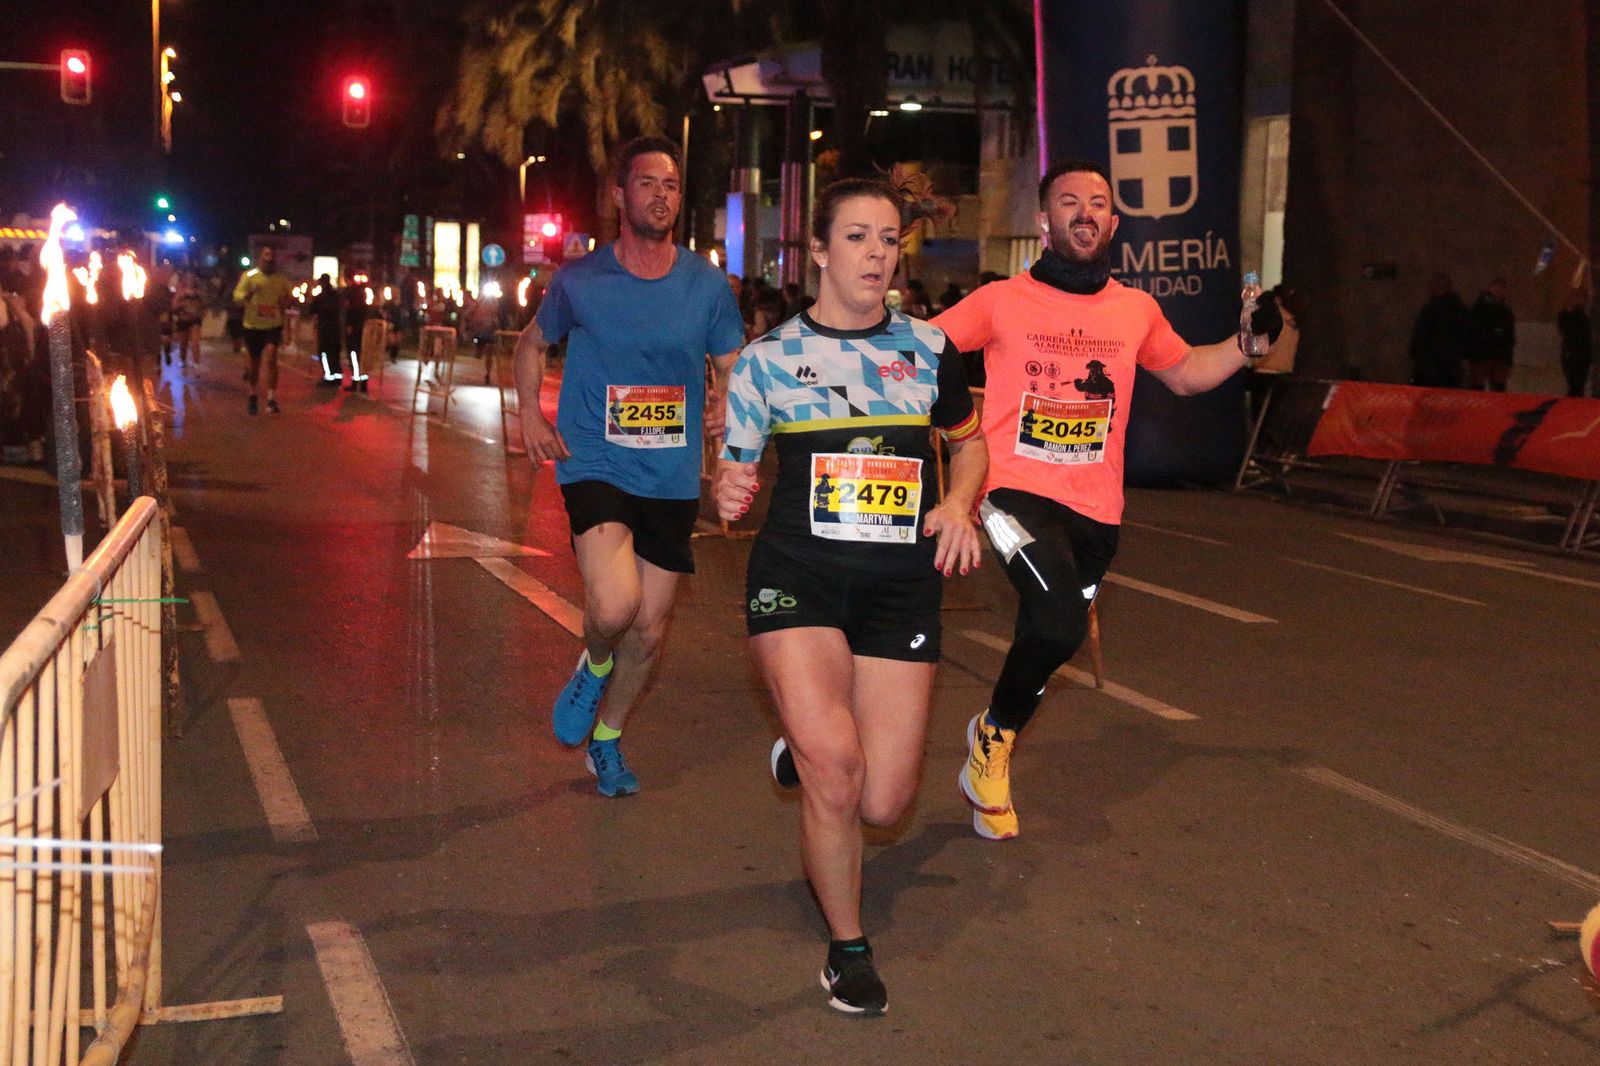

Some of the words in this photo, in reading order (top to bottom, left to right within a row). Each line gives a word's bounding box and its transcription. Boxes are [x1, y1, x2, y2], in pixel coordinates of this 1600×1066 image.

[883, 52, 933, 80] RAN
[1111, 230, 1232, 273] MERÍA
[1026, 333, 1072, 345] CARRERA
[1074, 339, 1126, 348] BOMBEROS
[1082, 346, 1120, 354] CIUDAD
[627, 405, 676, 421] 2455
[1040, 419, 1097, 438] 2045
[839, 482, 908, 507] 2479
[856, 513, 893, 525] MARTYNA
